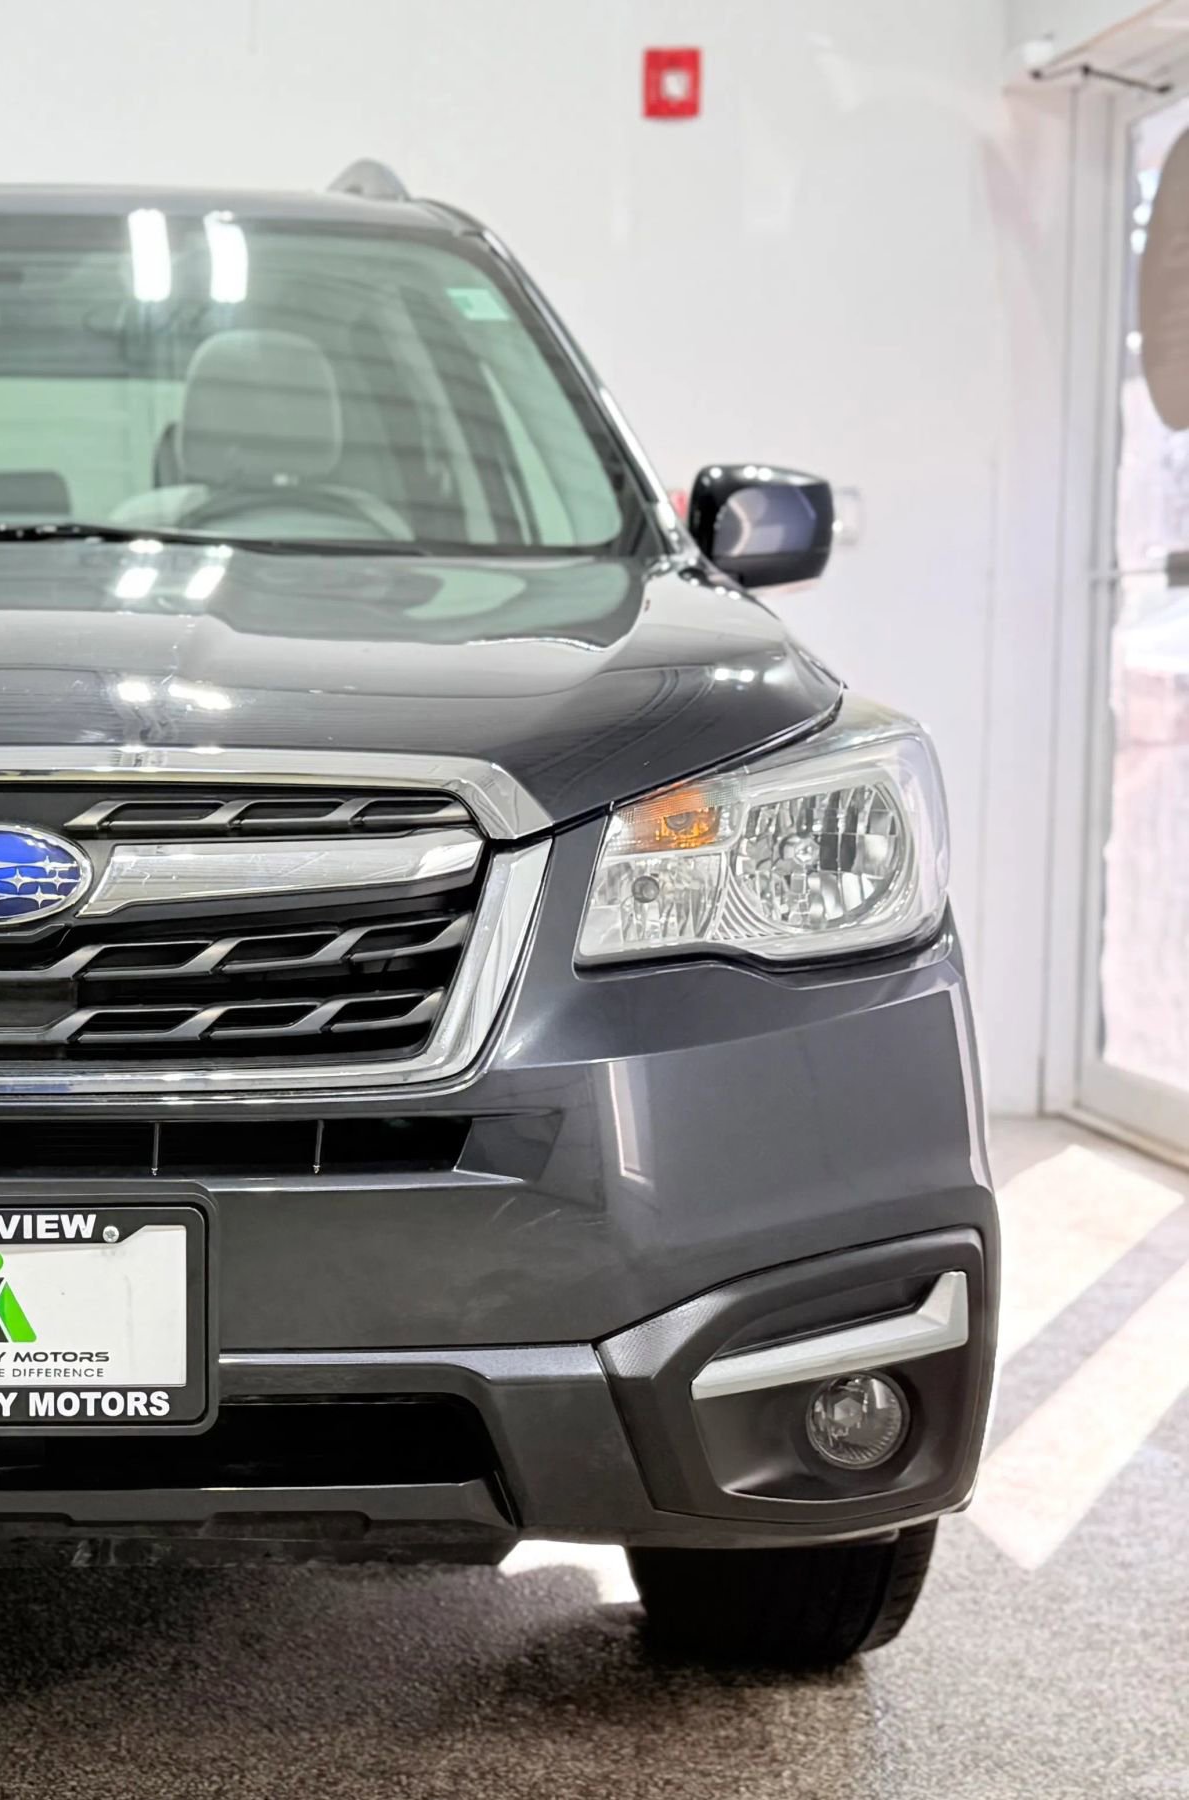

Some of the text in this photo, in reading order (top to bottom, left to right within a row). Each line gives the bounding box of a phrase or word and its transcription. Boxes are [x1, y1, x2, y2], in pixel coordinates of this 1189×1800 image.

[13, 1352, 110, 1363] MOTORS
[12, 1368, 104, 1378] DIFFERENCE
[28, 1391, 170, 1417] MOTORS
